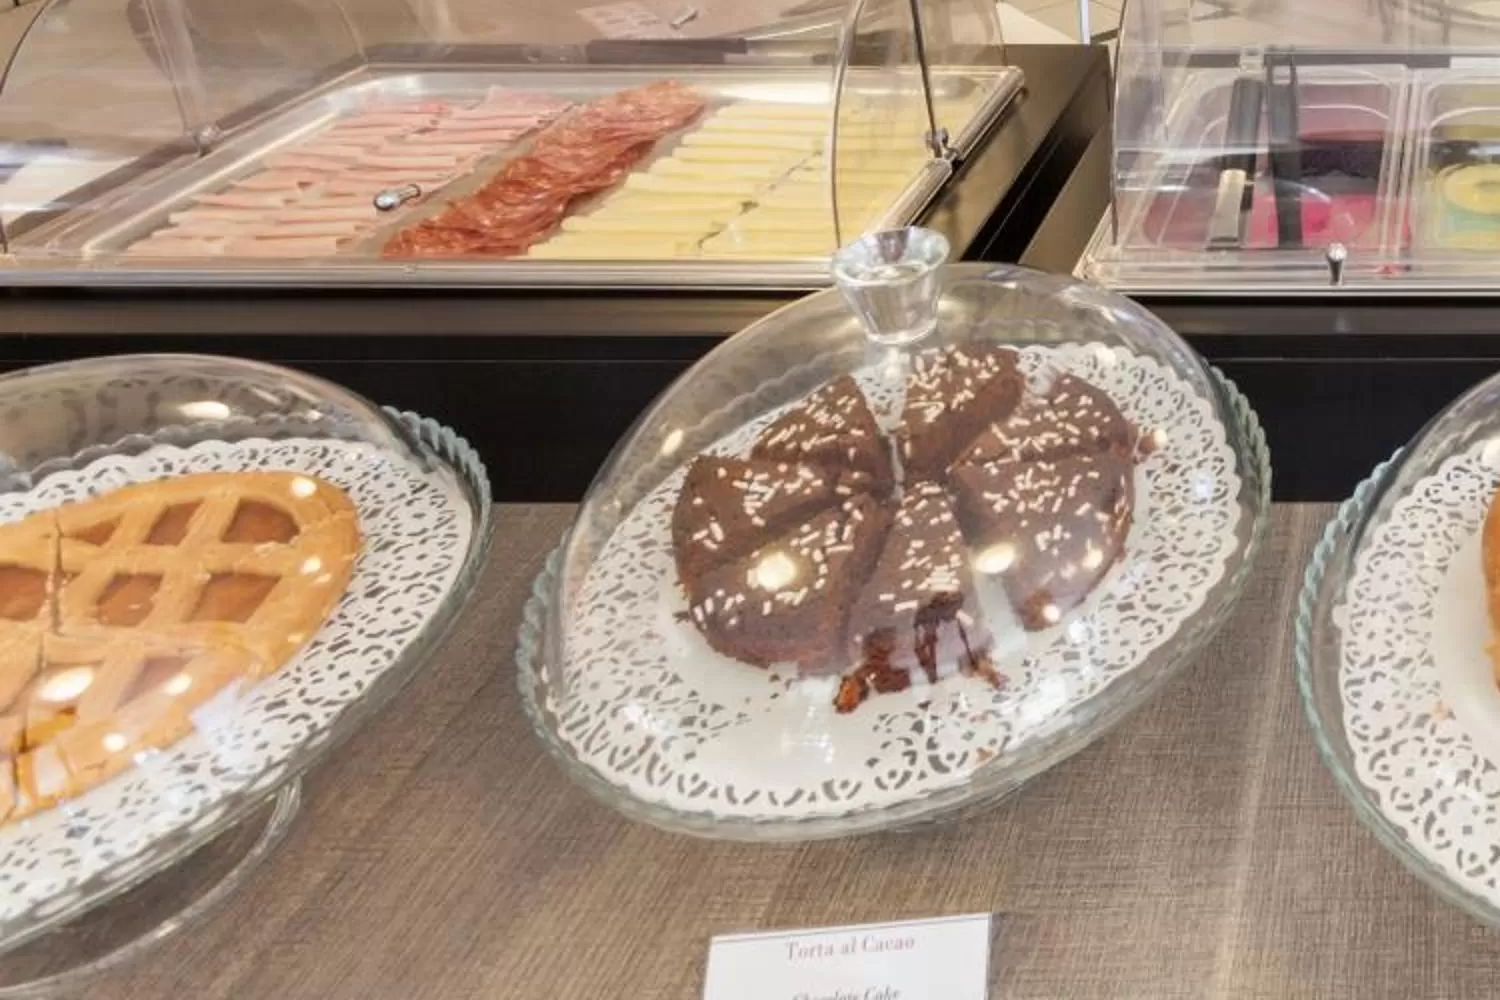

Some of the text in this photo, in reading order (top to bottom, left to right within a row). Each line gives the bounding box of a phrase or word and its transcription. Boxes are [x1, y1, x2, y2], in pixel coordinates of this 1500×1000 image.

[785, 934, 916, 961] Torta al Cacao
